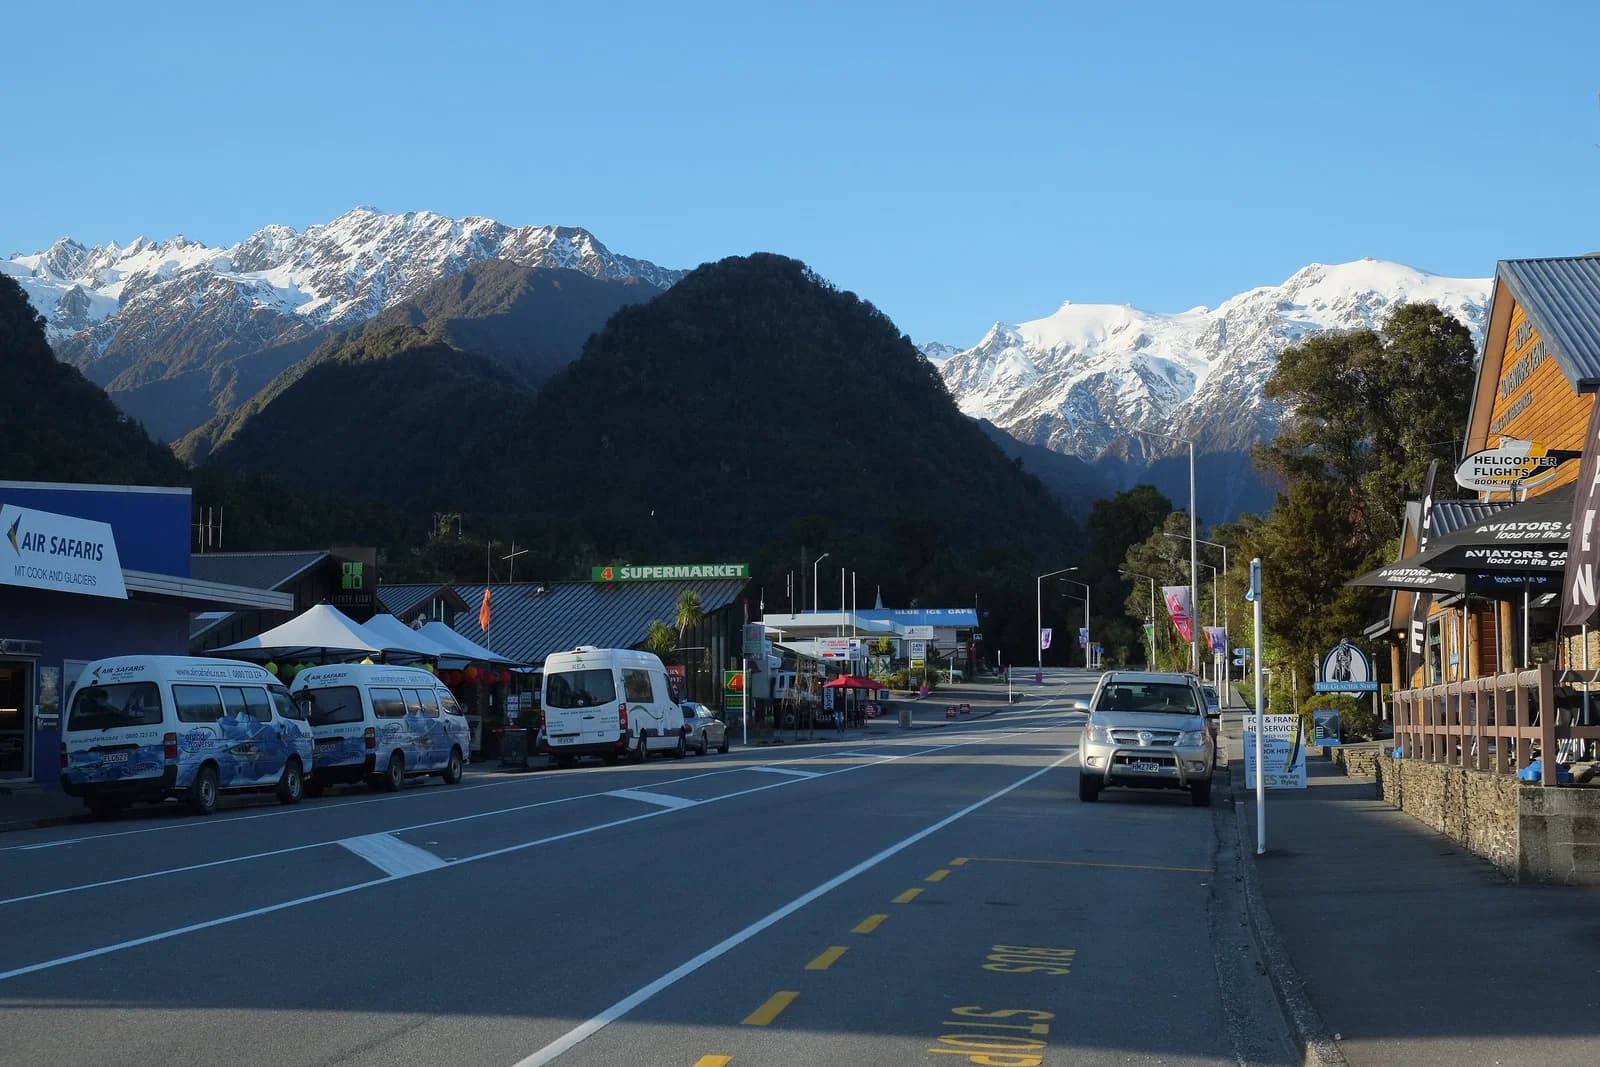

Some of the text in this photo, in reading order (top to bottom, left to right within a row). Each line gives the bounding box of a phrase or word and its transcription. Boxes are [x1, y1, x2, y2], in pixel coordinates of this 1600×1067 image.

[1474, 456, 1557, 466] HELICOPTER
[1474, 467, 1530, 477] FLIGHTS
[1475, 522, 1562, 533] AVIATORS
[1495, 531, 1526, 539] food
[21, 531, 104, 562] AIR SAFARIS
[1465, 550, 1543, 558] AVIATORS
[14, 565, 97, 586] MT COOK AND GLACIERS
[620, 564, 744, 579] SUPERMARKET
[1378, 568, 1431, 577] AVIATORS
[115, 664, 145, 672] SAFARIS
[1264, 774, 1278, 785] ES
[928, 945, 1076, 1067] BUS STOP
